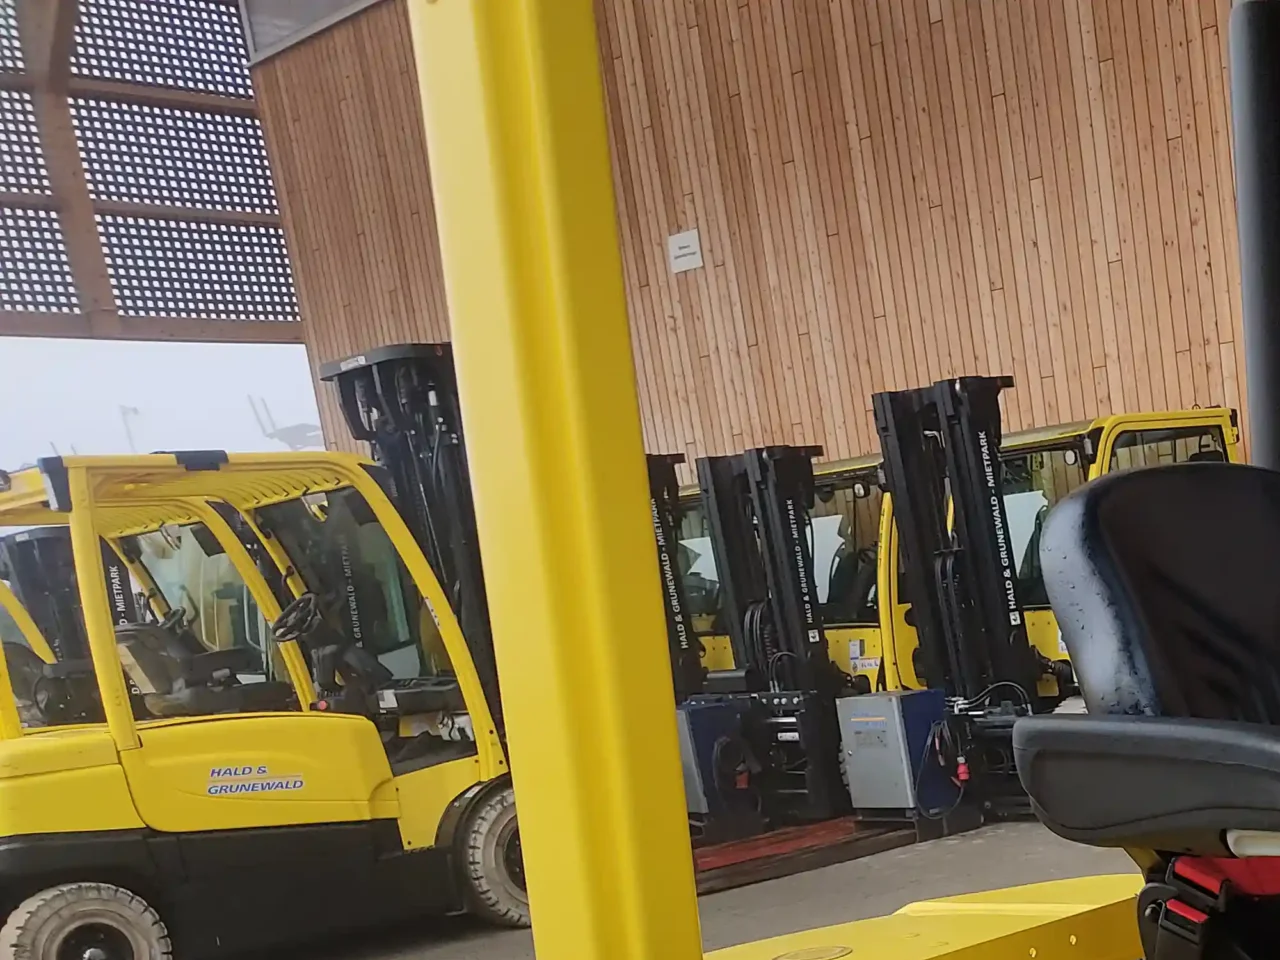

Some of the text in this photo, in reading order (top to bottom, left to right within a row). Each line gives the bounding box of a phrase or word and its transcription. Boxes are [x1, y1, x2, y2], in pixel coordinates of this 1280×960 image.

[978, 431, 995, 487] MIETPARK
[786, 499, 800, 539] MIETPARK
[991, 496, 1010, 567] GRUNEWALD
[661, 553, 680, 613] GRUNEWALD
[795, 545, 808, 595] GRUNEWALD
[1003, 568, 1013, 578] &
[109, 565, 126, 611] MIETPARK
[1005, 580, 1017, 609] HALD
[347, 585, 362, 638] GRUNEWALD
[674, 613, 683, 622] &
[804, 603, 813, 623] HALD
[676, 624, 689, 649] HALD
[207, 780, 304, 795] GRUNEWALD
[210, 765, 267, 778] HALD &
